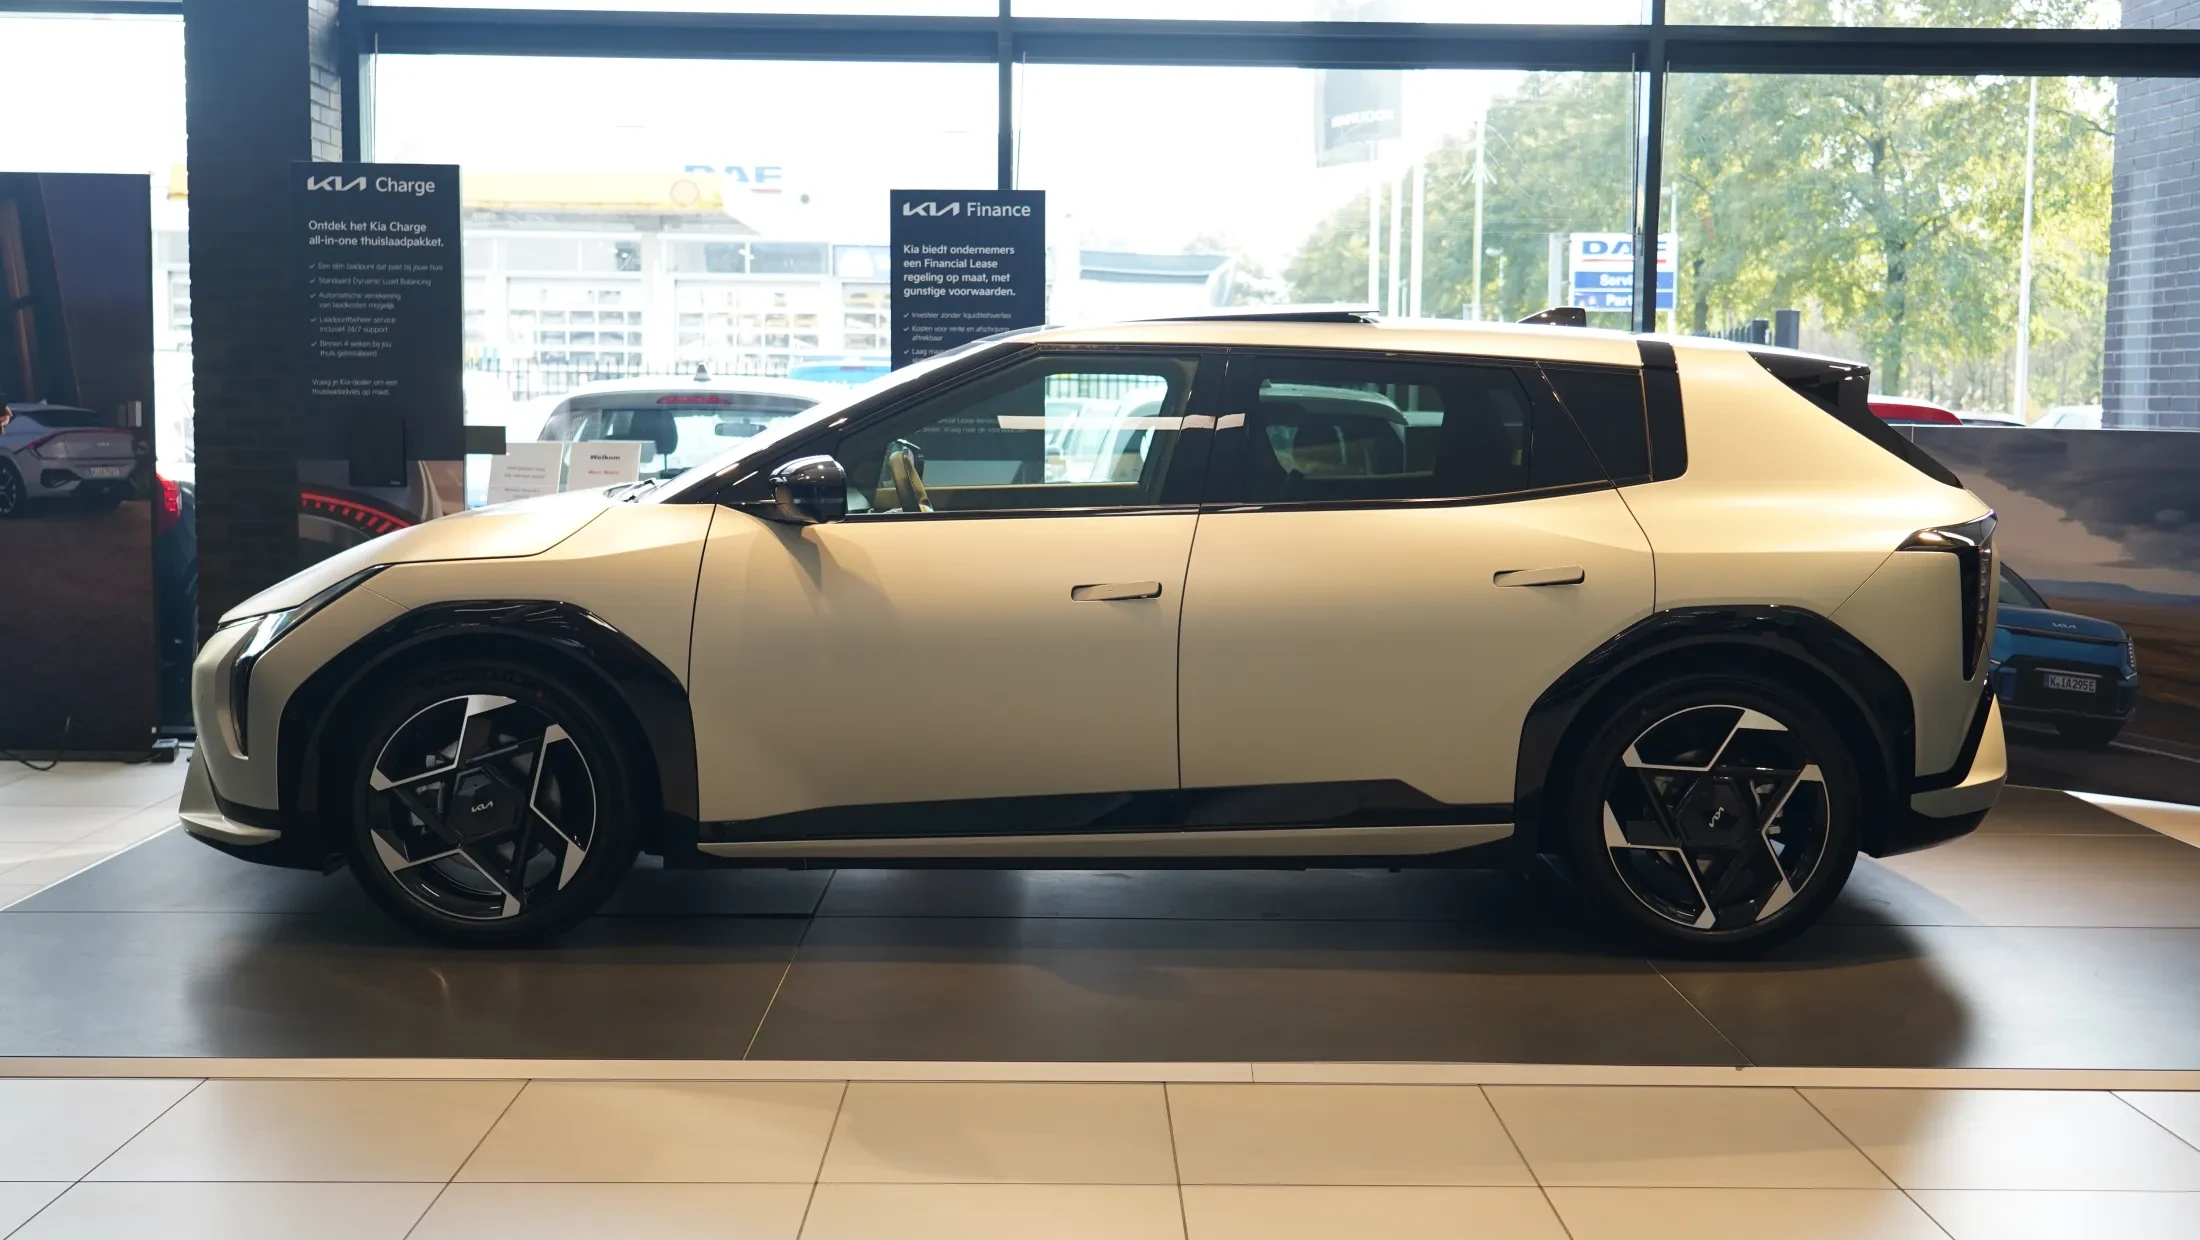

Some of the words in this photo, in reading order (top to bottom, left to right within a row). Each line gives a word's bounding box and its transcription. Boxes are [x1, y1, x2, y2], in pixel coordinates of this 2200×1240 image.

[307, 176, 367, 191] KIA
[375, 177, 435, 196] Charge
[903, 202, 960, 216] KIA
[967, 202, 1031, 217] Finance
[308, 220, 347, 231] Ontdek
[350, 221, 367, 231] het
[370, 222, 387, 232] Kia
[389, 221, 427, 234] Charge
[309, 235, 358, 246] all-in-one
[361, 236, 444, 248] thuislaadpakket.
[903, 245, 920, 254] Kia
[922, 245, 948, 254] biedt
[950, 245, 1015, 255] ondernemers
[903, 259, 922, 268] een
[924, 258, 967, 268] Financial
[970, 259, 998, 268] Lease
[903, 272, 943, 283] regeling
[946, 274, 959, 283] op
[962, 273, 988, 283] maat,
[991, 273, 1010, 282] met
[903, 287, 946, 297] gunstige
[948, 287, 1016, 296] voorwaarden.
